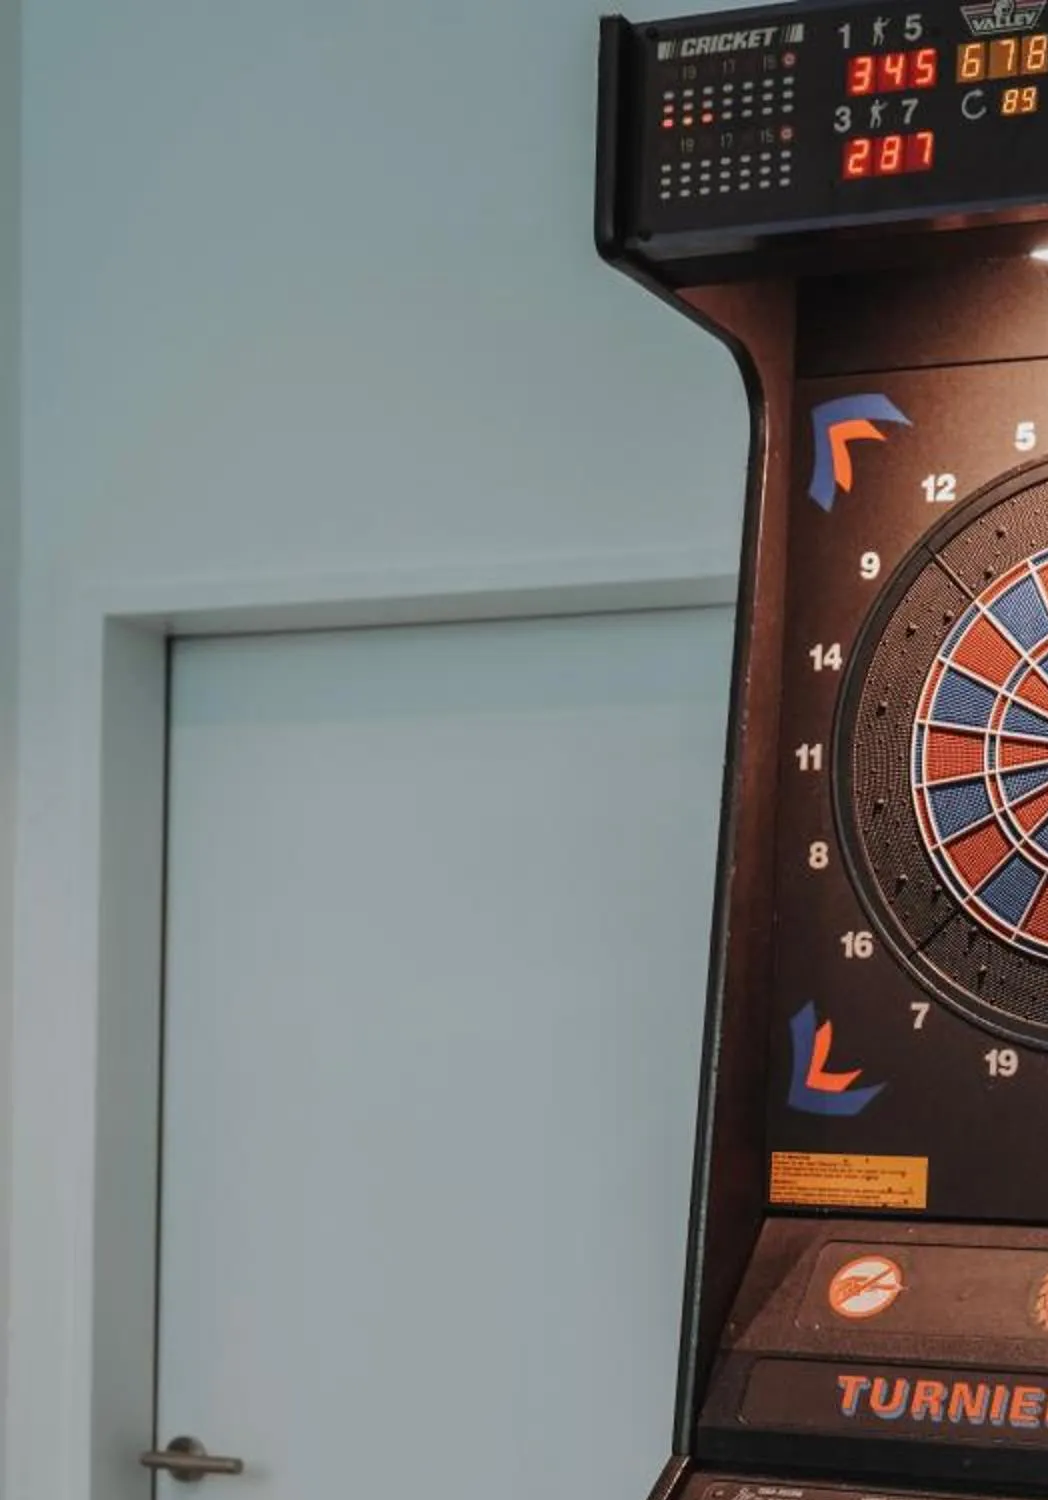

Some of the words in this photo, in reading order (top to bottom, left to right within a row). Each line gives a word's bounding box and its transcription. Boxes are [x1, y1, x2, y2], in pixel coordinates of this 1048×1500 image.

[838, 24, 851, 49] 1
[904, 14, 923, 41] 5
[972, 11, 1036, 31] VALLEY
[680, 27, 779, 57] CRICKET
[960, 34, 1048, 79] 678
[850, 49, 936, 93] 345
[1002, 87, 1039, 114] 89
[834, 106, 852, 132] 3
[901, 99, 919, 124] 7
[847, 130, 934, 175] 287
[1015, 422, 1036, 451] 5
[921, 474, 956, 502] 12
[860, 551, 881, 579] 9
[809, 643, 843, 671] 14
[795, 743, 823, 771] 11
[808, 841, 829, 869] 8
[841, 931, 873, 958] 16
[910, 1002, 930, 1029] 7
[984, 1048, 1019, 1076] 19
